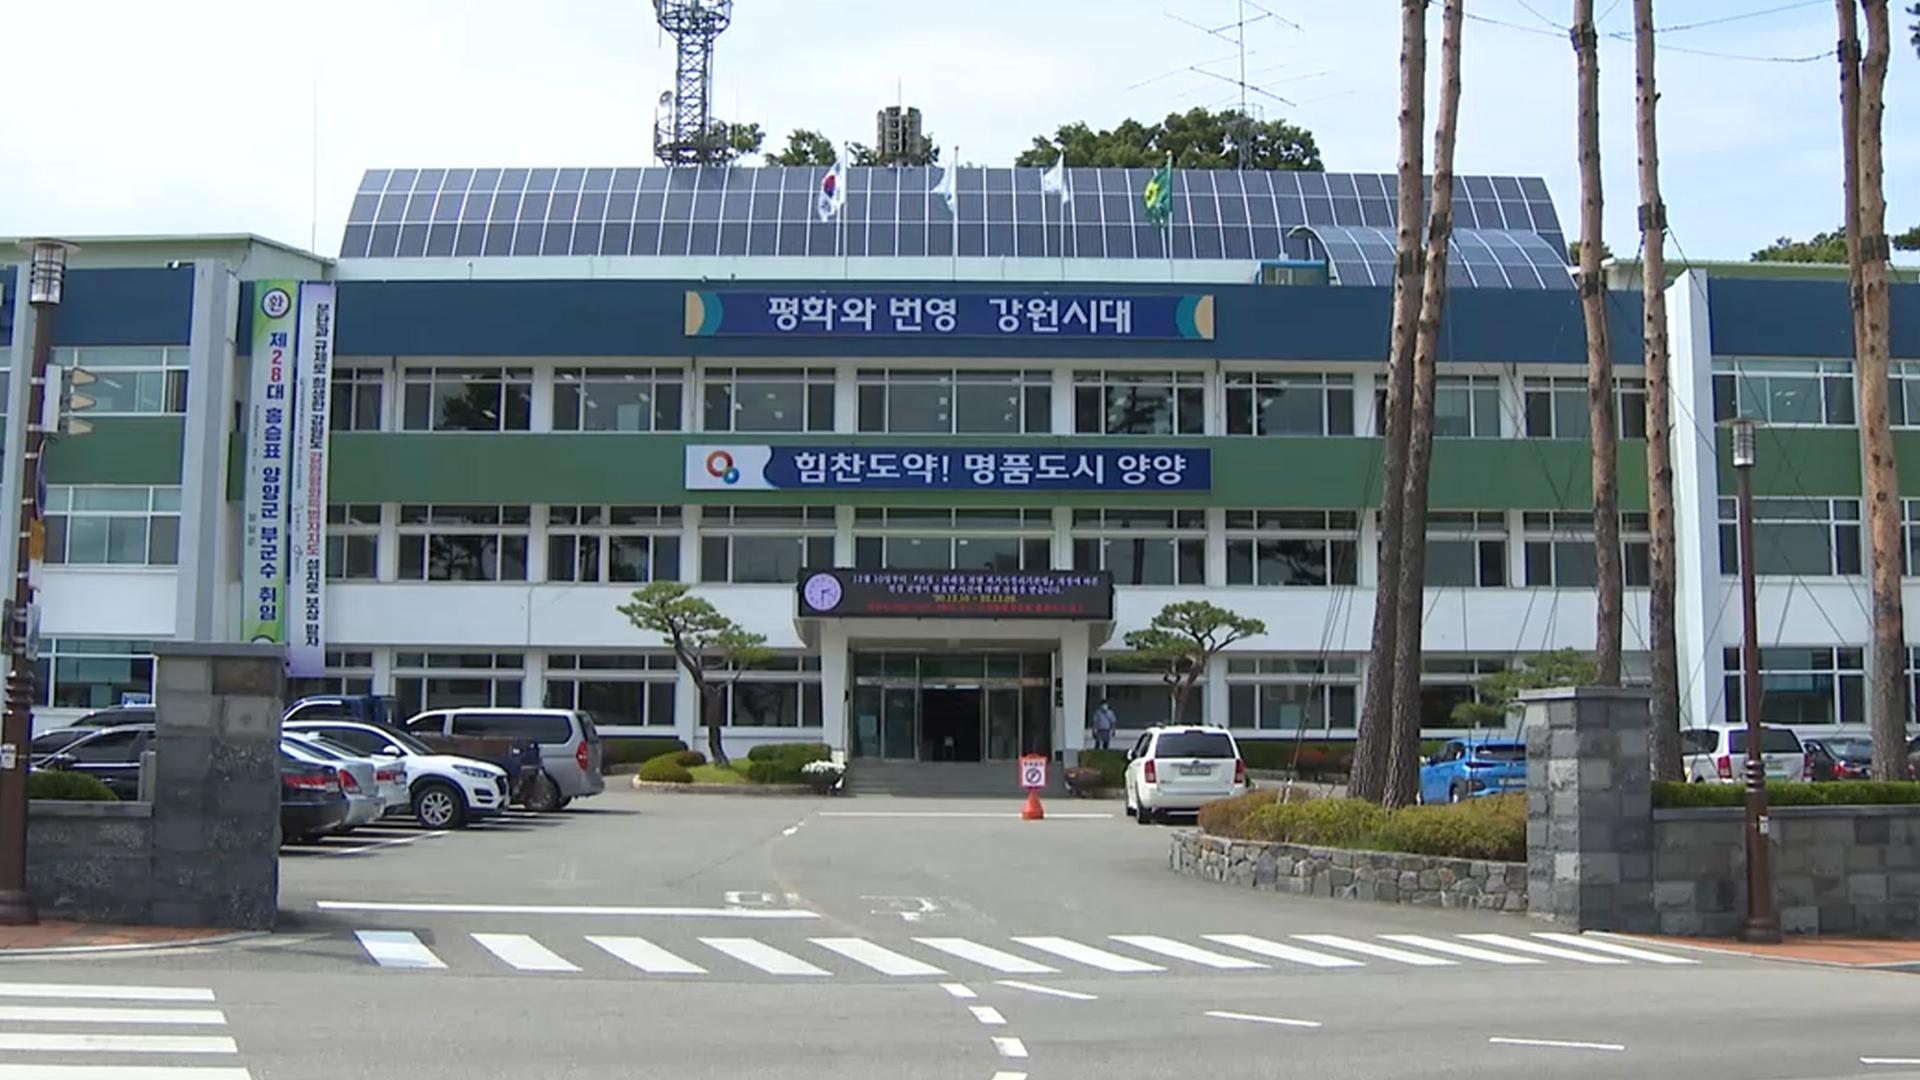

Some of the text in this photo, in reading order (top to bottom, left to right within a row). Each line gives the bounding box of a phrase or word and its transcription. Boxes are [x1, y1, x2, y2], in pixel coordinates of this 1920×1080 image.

[768, 297, 1132, 334] 평화와 번영 강원시대
[266, 332, 288, 400] 제28대
[794, 452, 1187, 486] 힘찬도약! 명품도시 양양
[261, 465, 280, 519] 양양군
[260, 526, 278, 579] 부군수
[259, 586, 276, 620] 취임
